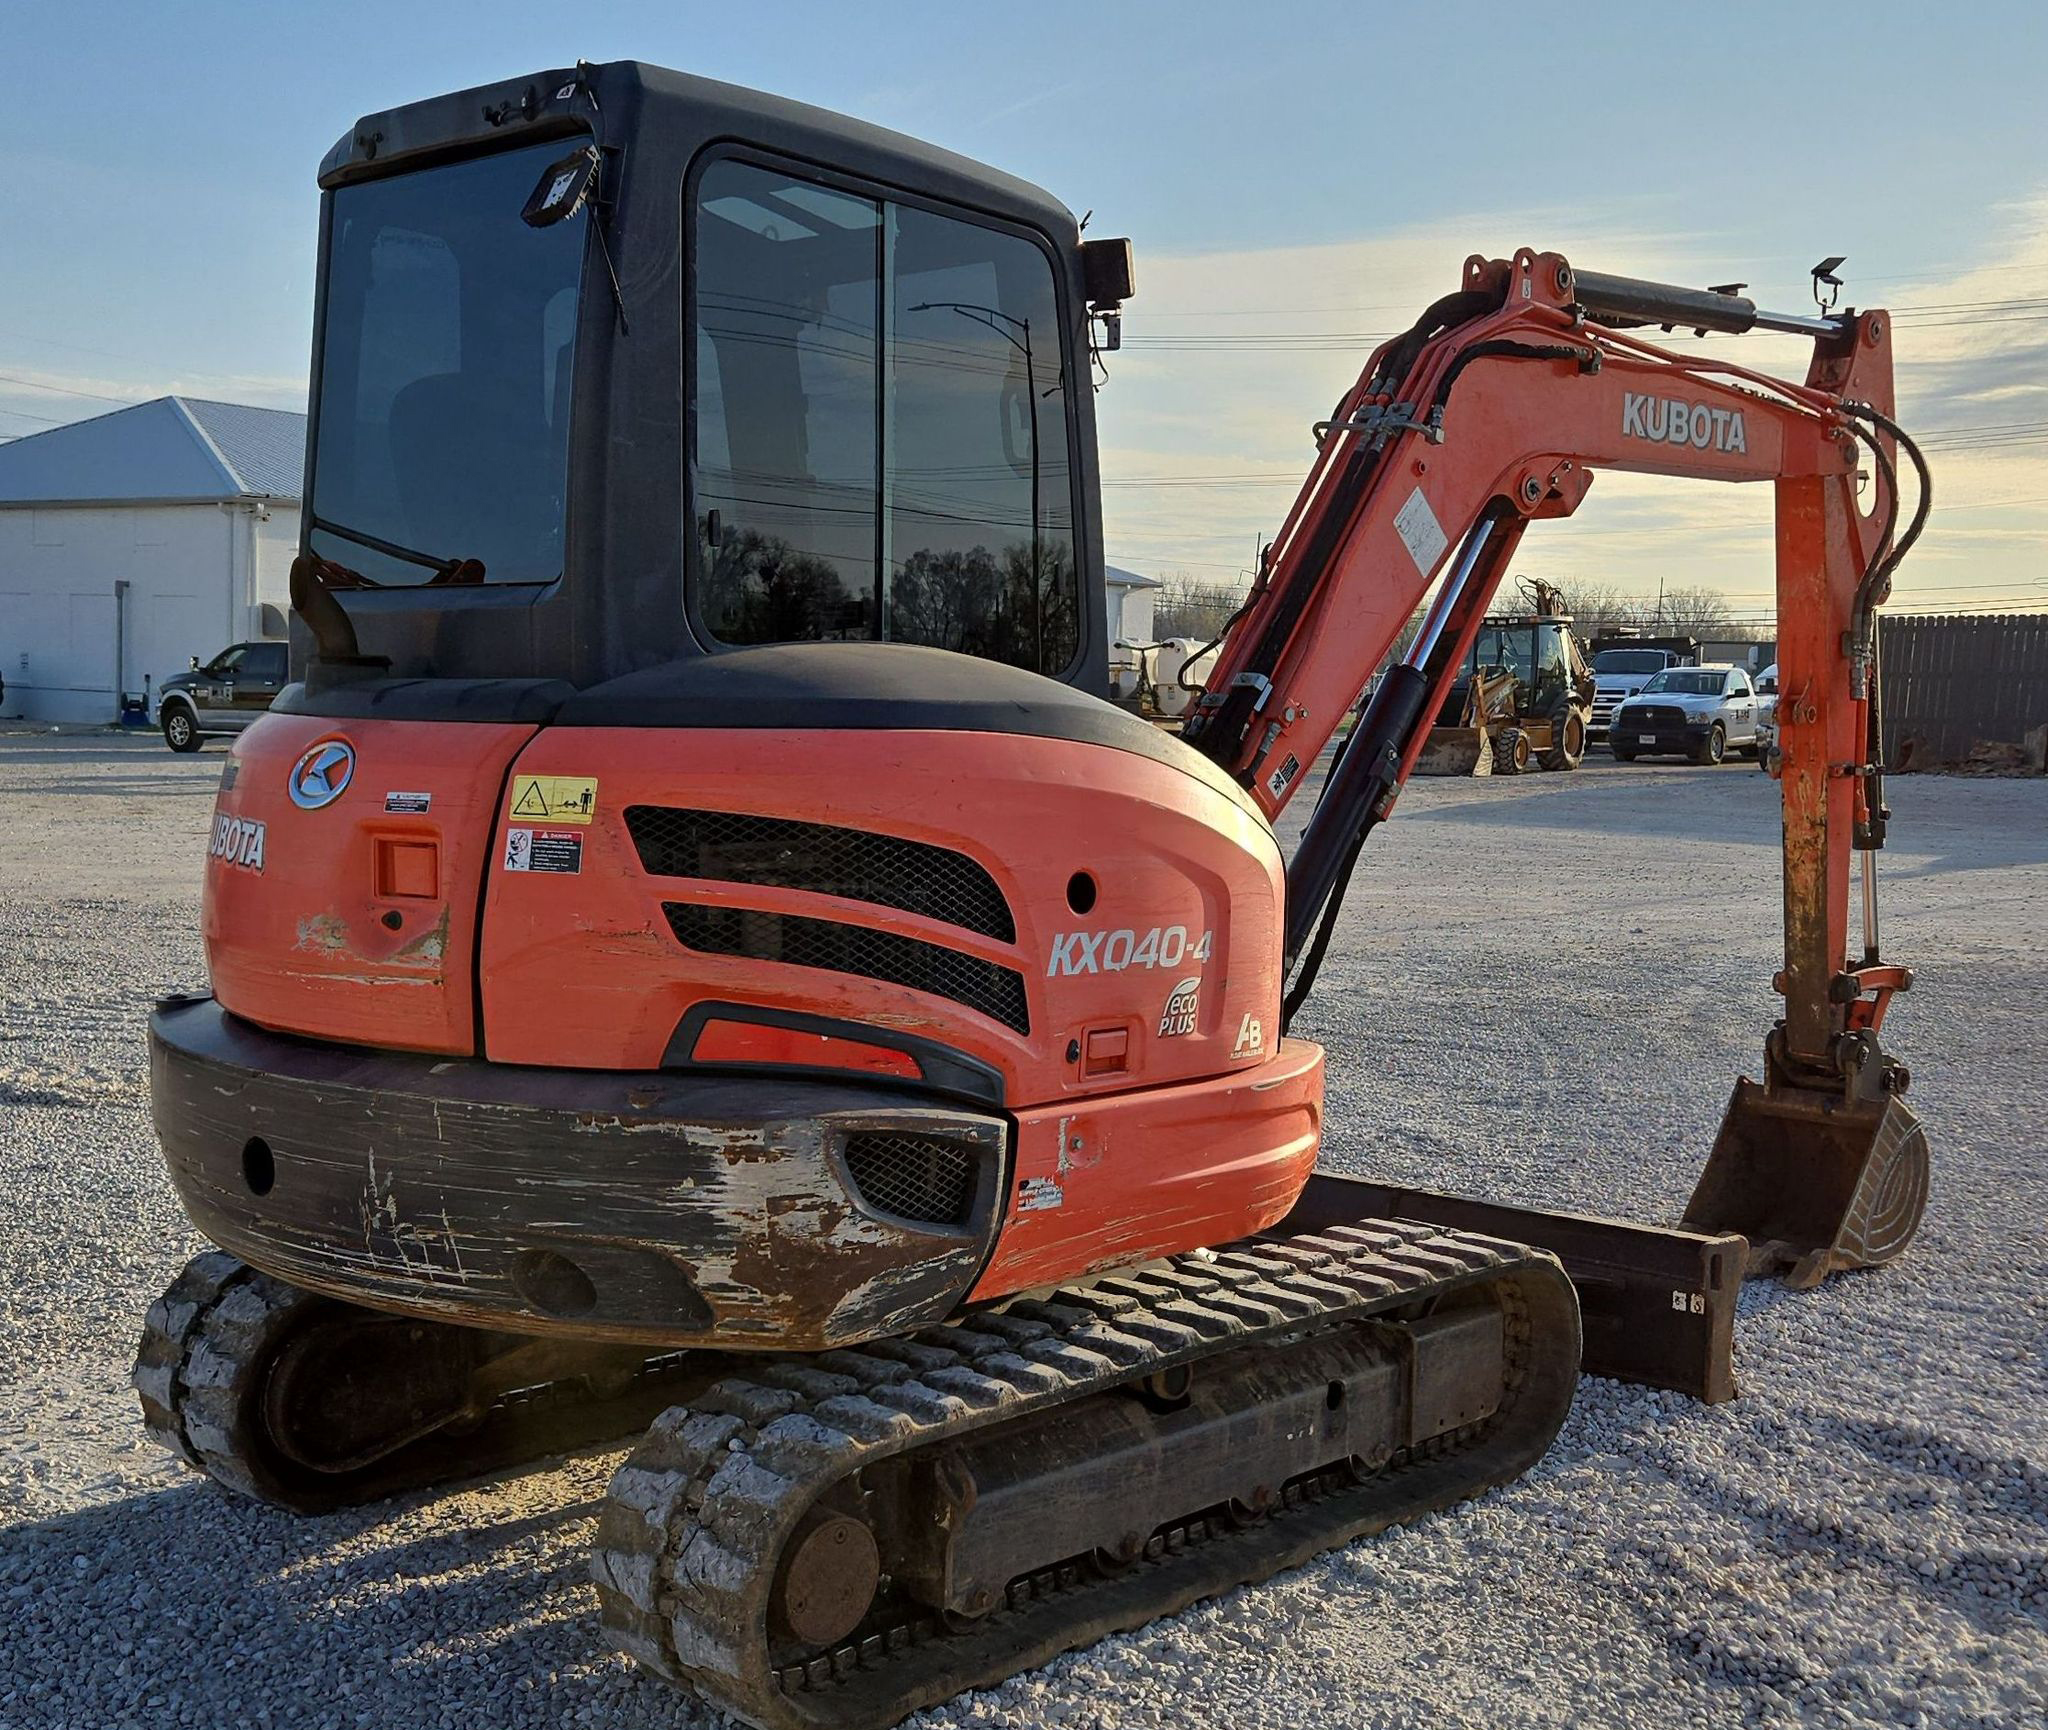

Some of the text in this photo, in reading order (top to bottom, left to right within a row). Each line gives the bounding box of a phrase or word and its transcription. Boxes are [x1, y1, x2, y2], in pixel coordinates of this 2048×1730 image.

[1622, 391, 1748, 455] KUBOTA
[211, 813, 266, 870] UBOTA
[1046, 925, 1213, 977] KX040-4
[1157, 1013, 1197, 1038] PLUS
[1169, 993, 1198, 1016] eco
[1234, 1011, 1262, 1051] AB
